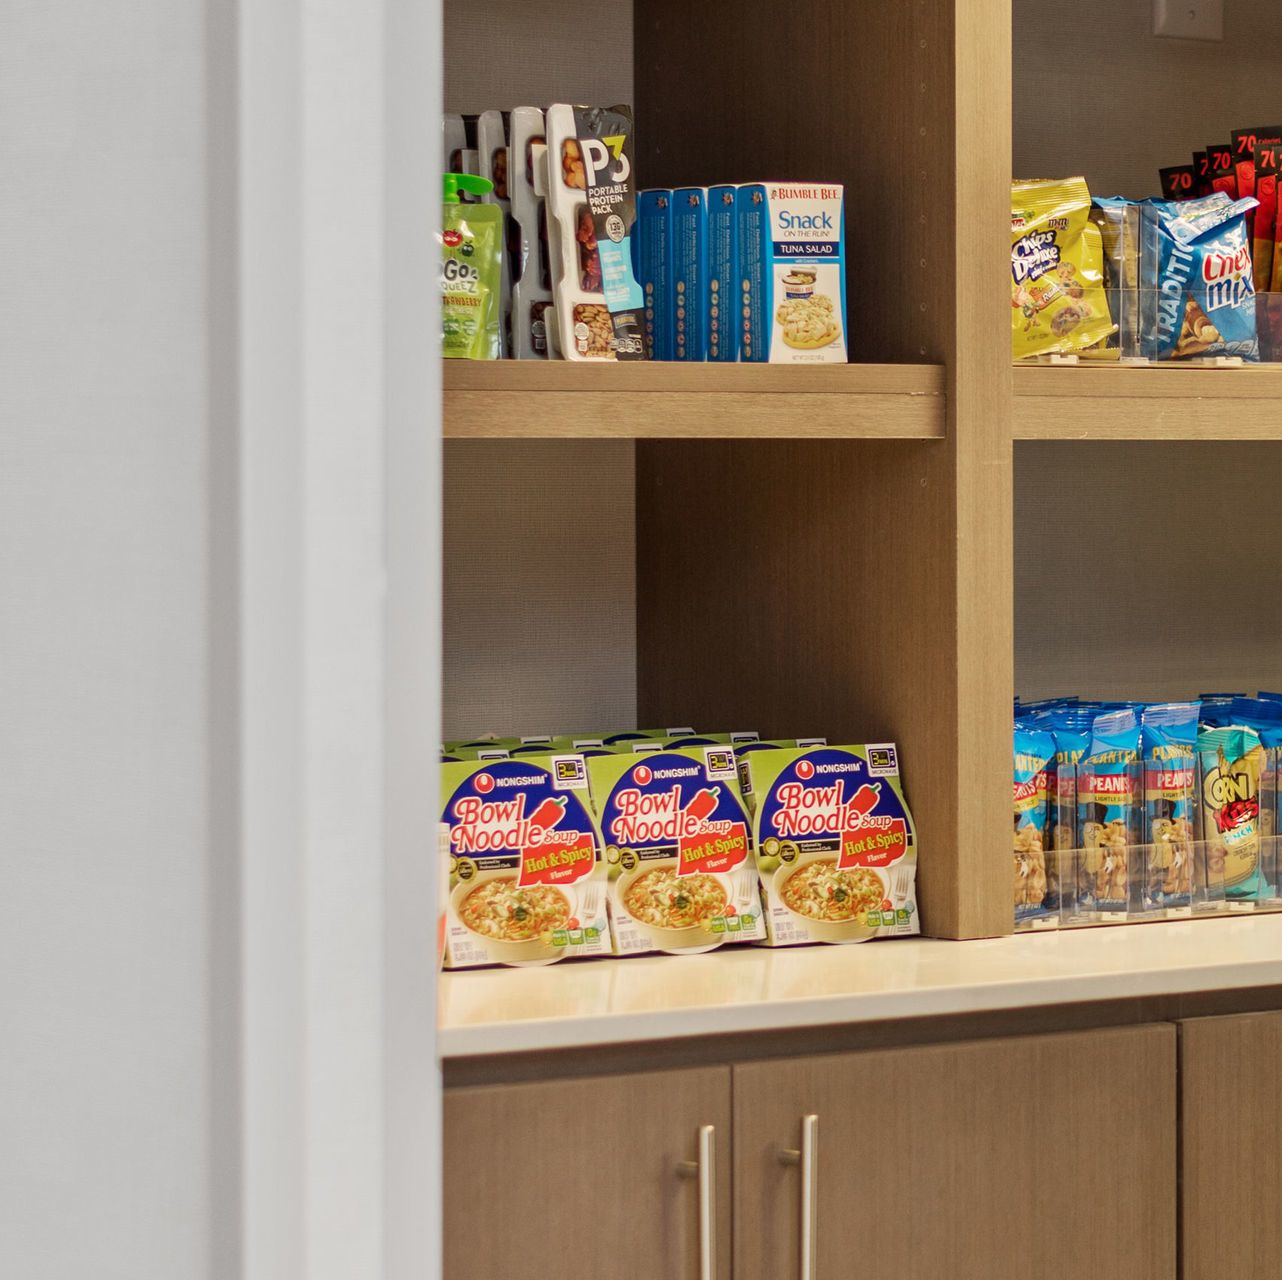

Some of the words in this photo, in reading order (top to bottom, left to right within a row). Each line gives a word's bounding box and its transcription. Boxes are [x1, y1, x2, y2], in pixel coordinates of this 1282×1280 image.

[580, 135, 630, 187] P3
[1213, 152, 1231, 169] 70
[588, 183, 629, 197] PORTABLE
[1169, 172, 1192, 190] 70
[589, 194, 624, 207] PROTEIN
[778, 188, 818, 200] BUMBLE
[821, 188, 839, 200] BEE
[591, 204, 613, 215] PACK
[778, 210, 833, 230] Snack
[780, 244, 805, 254] TUNA
[805, 244, 833, 254] SALAD
[1012, 231, 1054, 259] Chips
[616, 785, 680, 817] Bowl
[779, 781, 843, 809] Bowl
[456, 794, 525, 824] Bowl
[612, 812, 698, 844] Noodle
[700, 819, 731, 834] Soup
[774, 809, 859, 836] Noodle
[861, 815, 891, 828] Soup
[451, 821, 542, 851] Noodle
[544, 829, 578, 844] Soup
[845, 840, 865, 856] Hot
[866, 838, 877, 850] &
[877, 830, 905, 848] Spicy
[525, 856, 548, 873] Hot
[549, 854, 561, 867] &
[561, 846, 592, 865] Spicy
[682, 845, 703, 862] Hot
[704, 843, 715, 855] &
[715, 835, 745, 855] Spicy
[866, 852, 888, 863] Flavor
[550, 868, 573, 880] Flavor
[706, 857, 728, 868] Flavor
